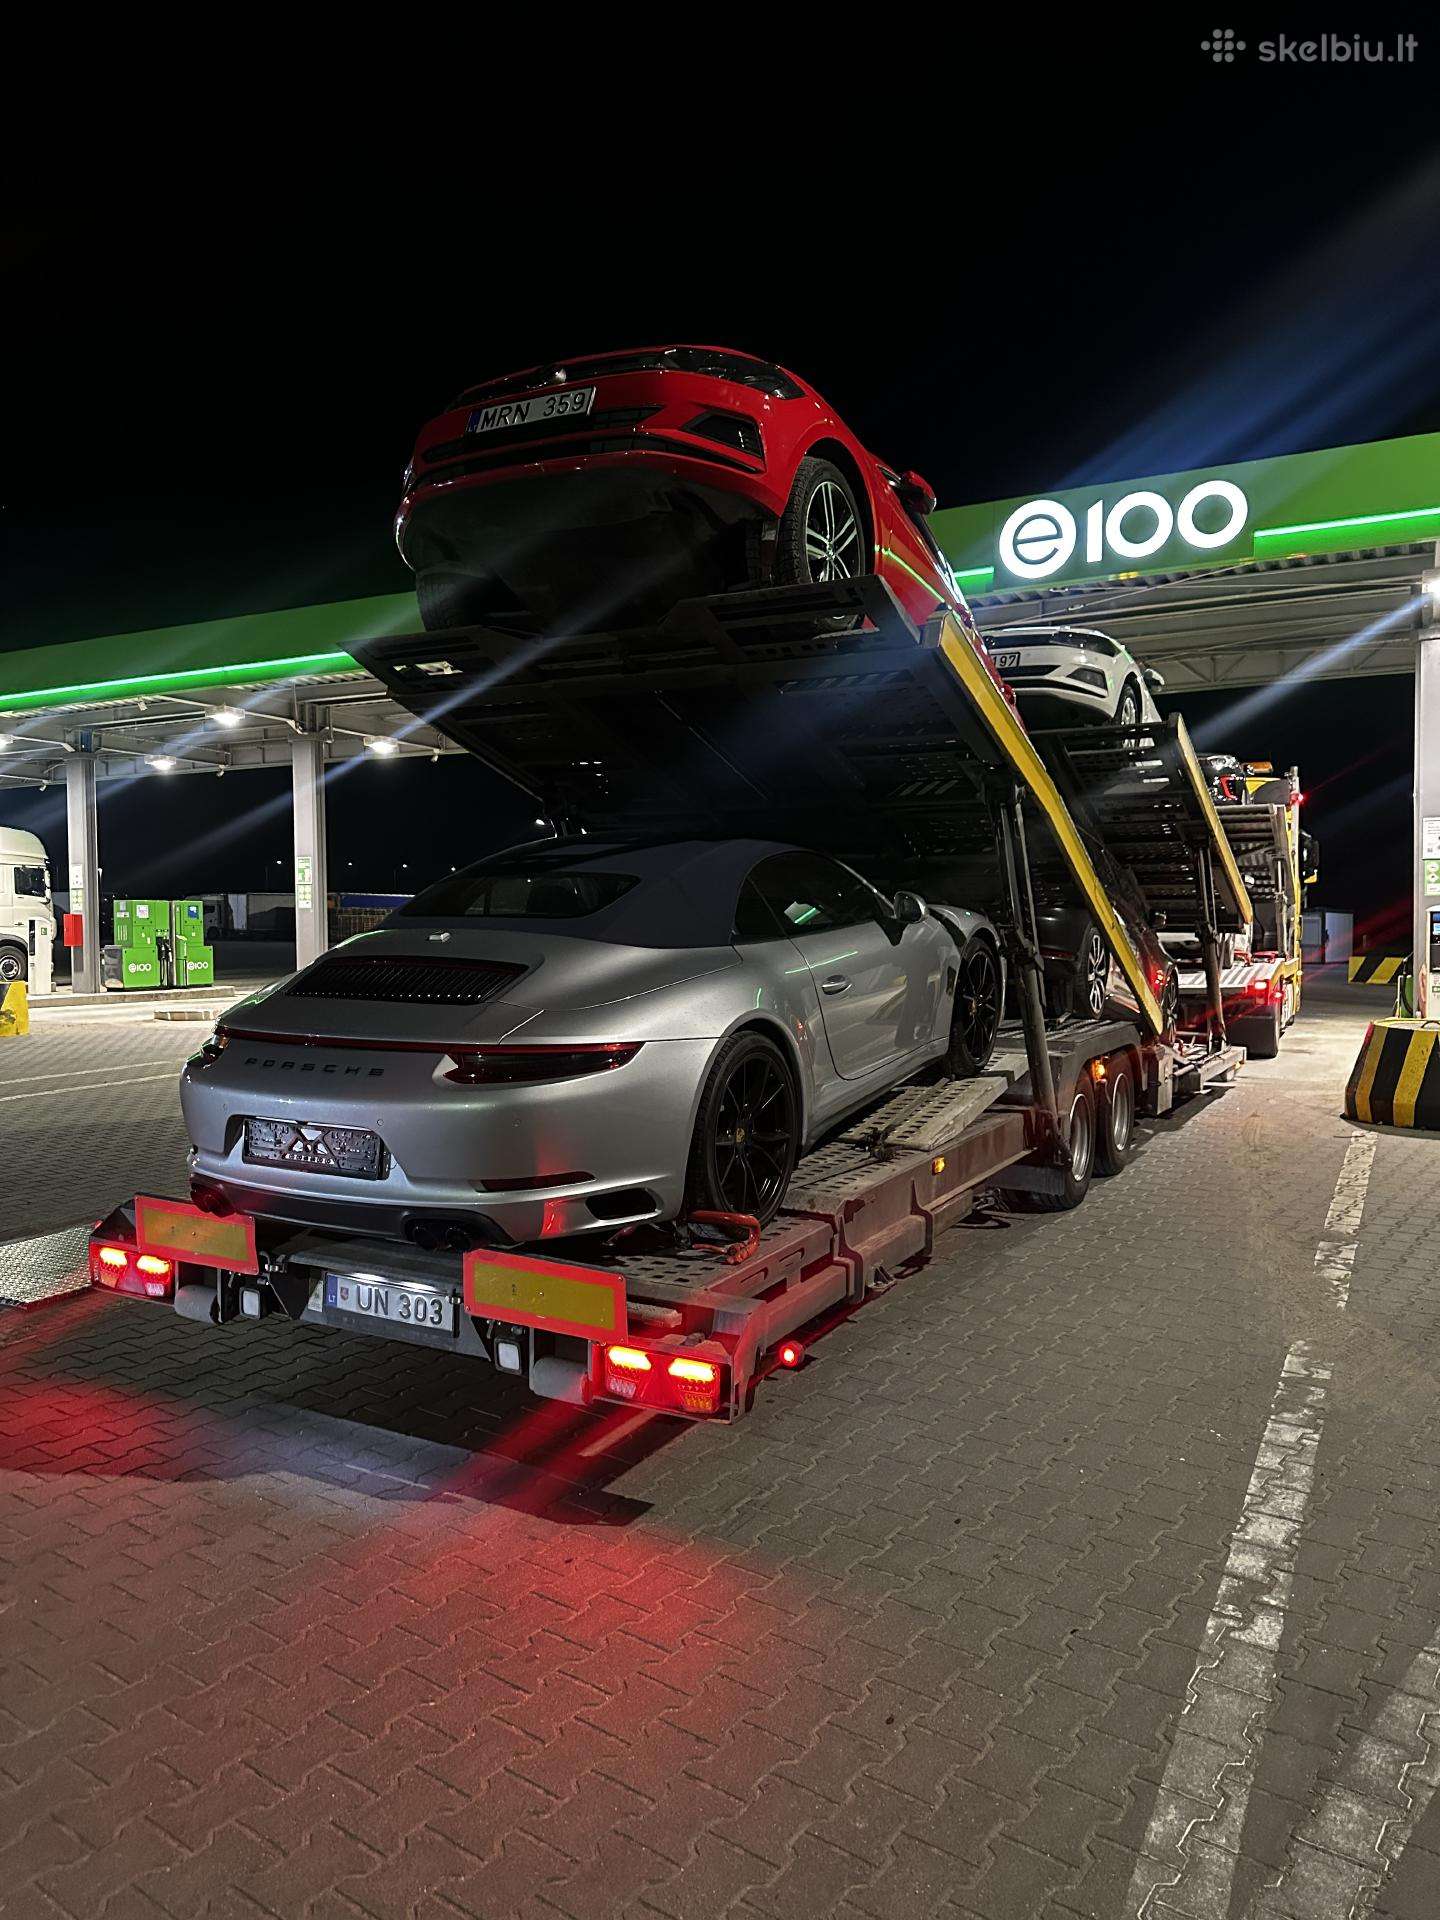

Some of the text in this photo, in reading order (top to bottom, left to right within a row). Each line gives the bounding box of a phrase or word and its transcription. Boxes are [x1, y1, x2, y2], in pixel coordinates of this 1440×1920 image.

[480, 392, 586, 430] MRN 359
[245, 1057, 385, 1077] PORSCHE
[328, 1294, 336, 1303] LT
[356, 1284, 443, 1325] UN 303
